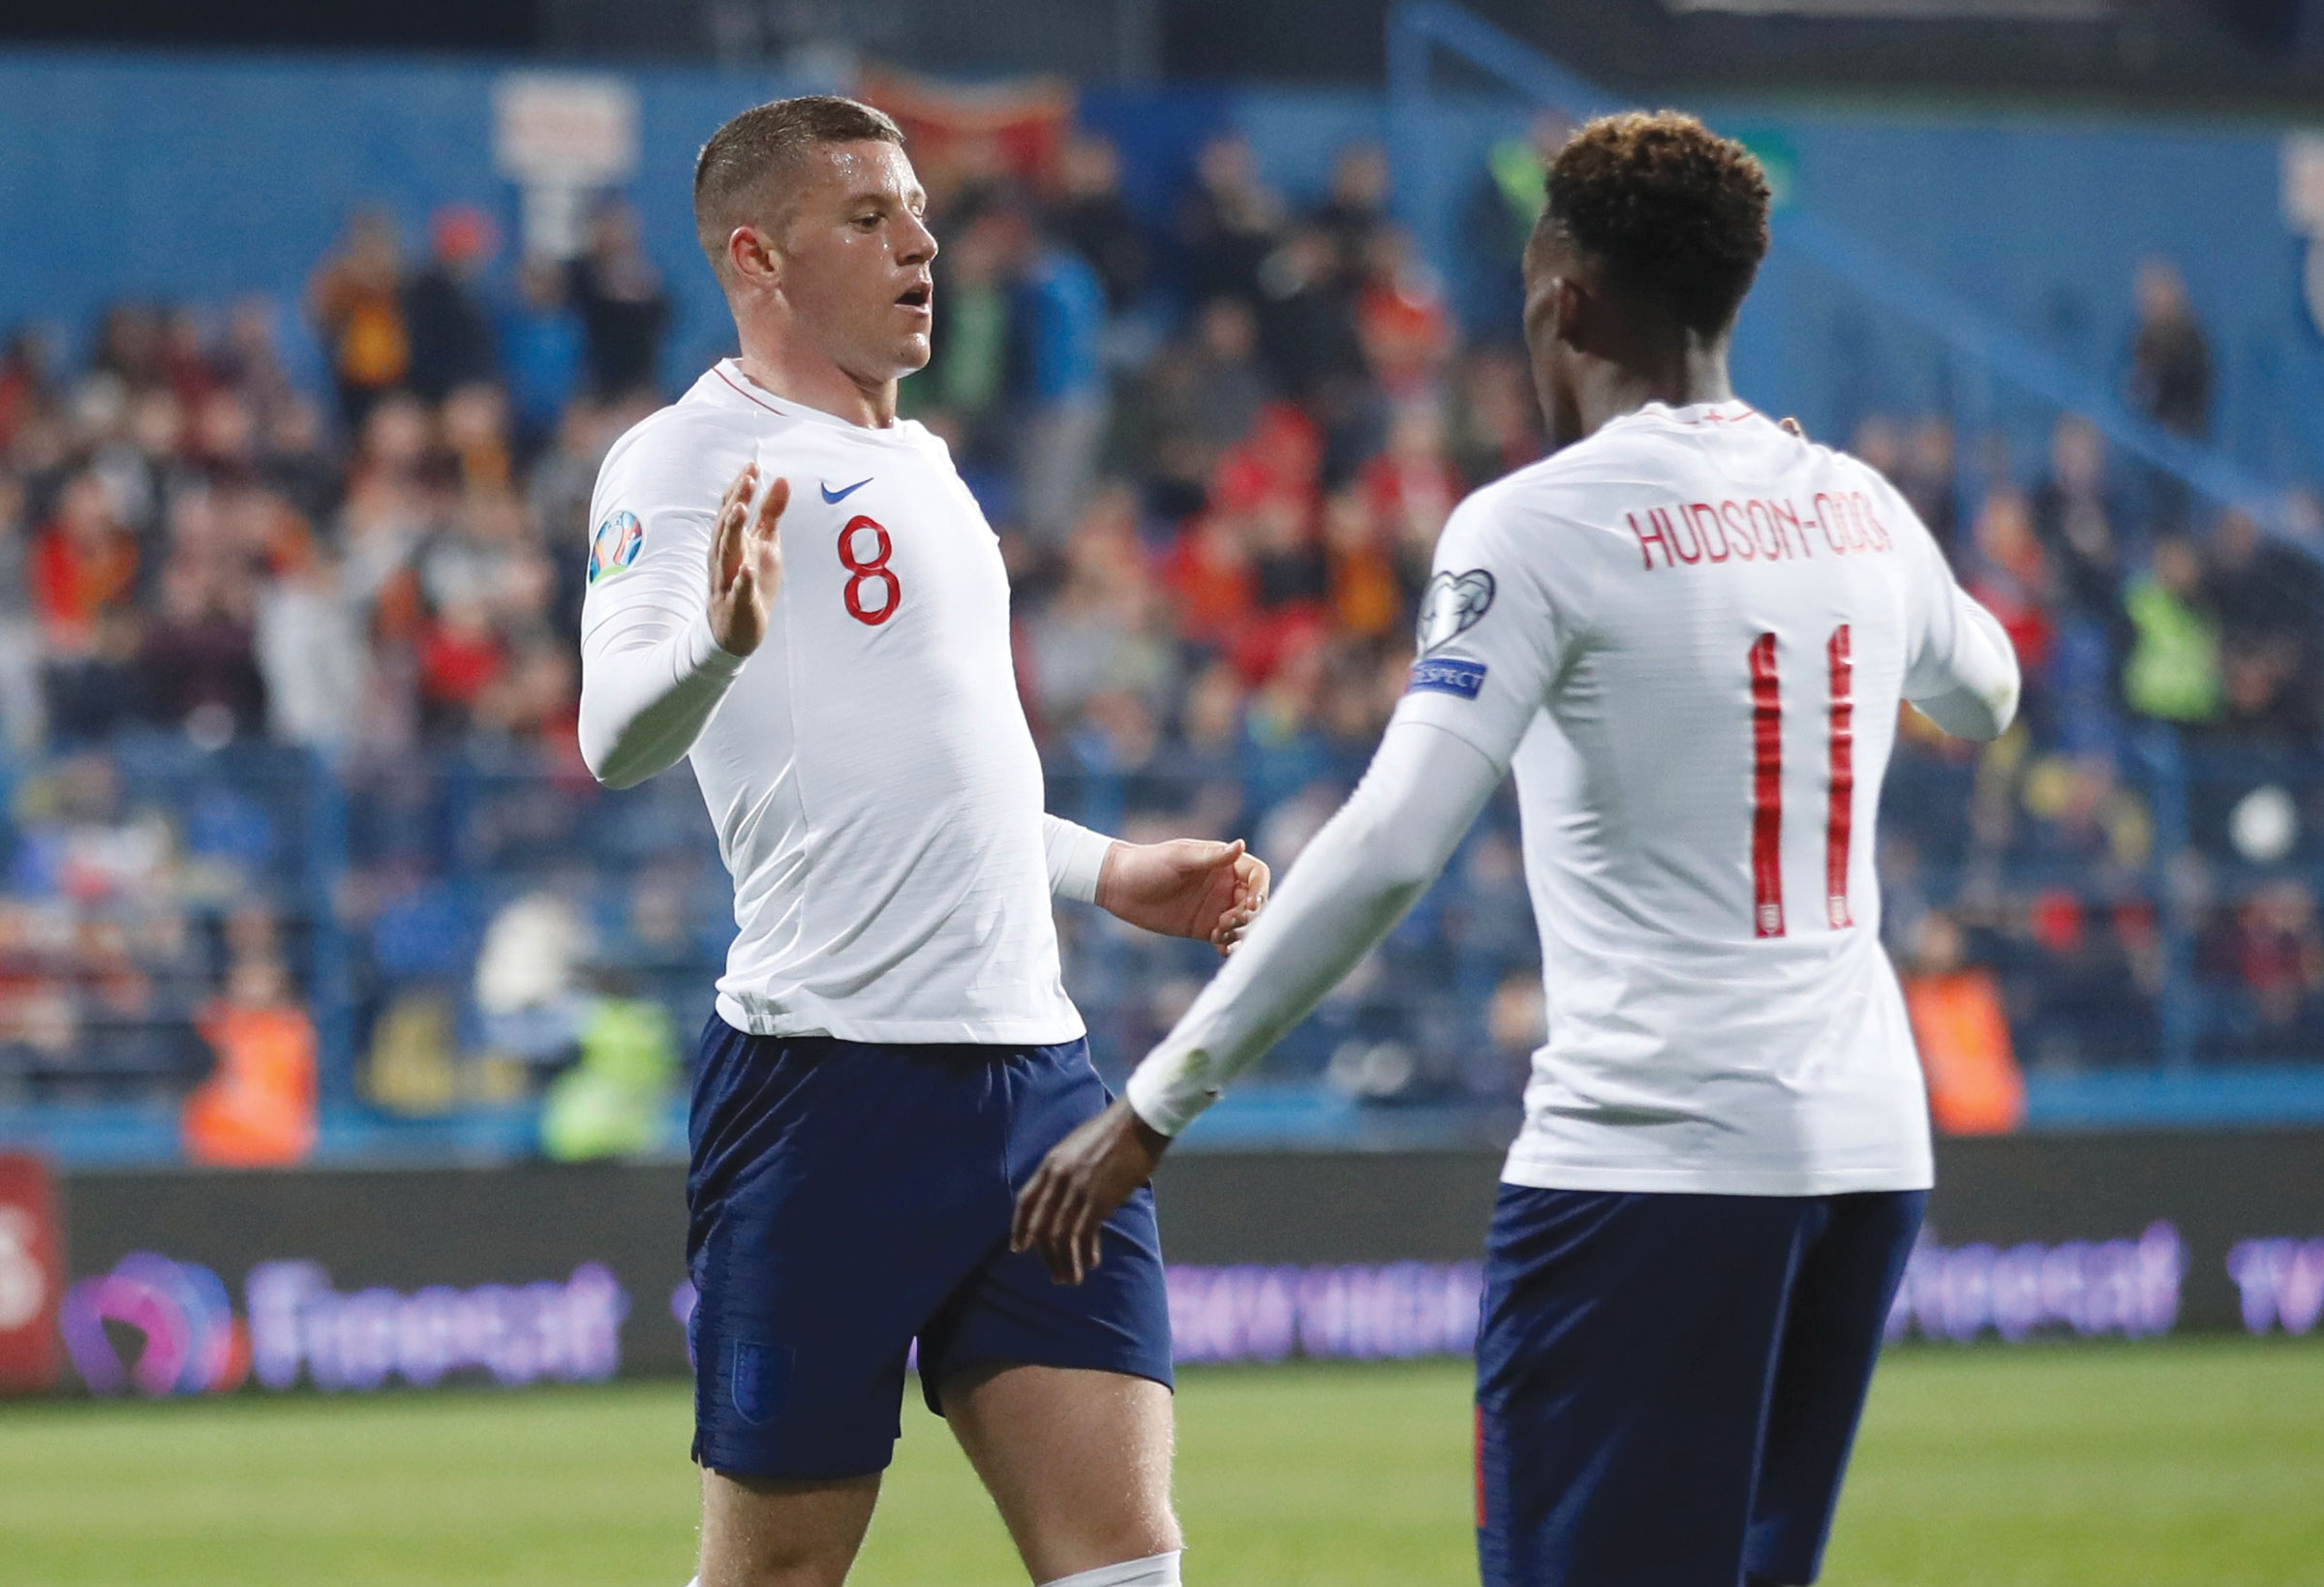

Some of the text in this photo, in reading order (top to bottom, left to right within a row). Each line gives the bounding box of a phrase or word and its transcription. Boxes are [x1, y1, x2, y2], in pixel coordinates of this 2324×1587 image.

[838, 515, 901, 626] 8
[1410, 667, 1484, 688] ESPECT
[1748, 624, 1854, 938] 11
